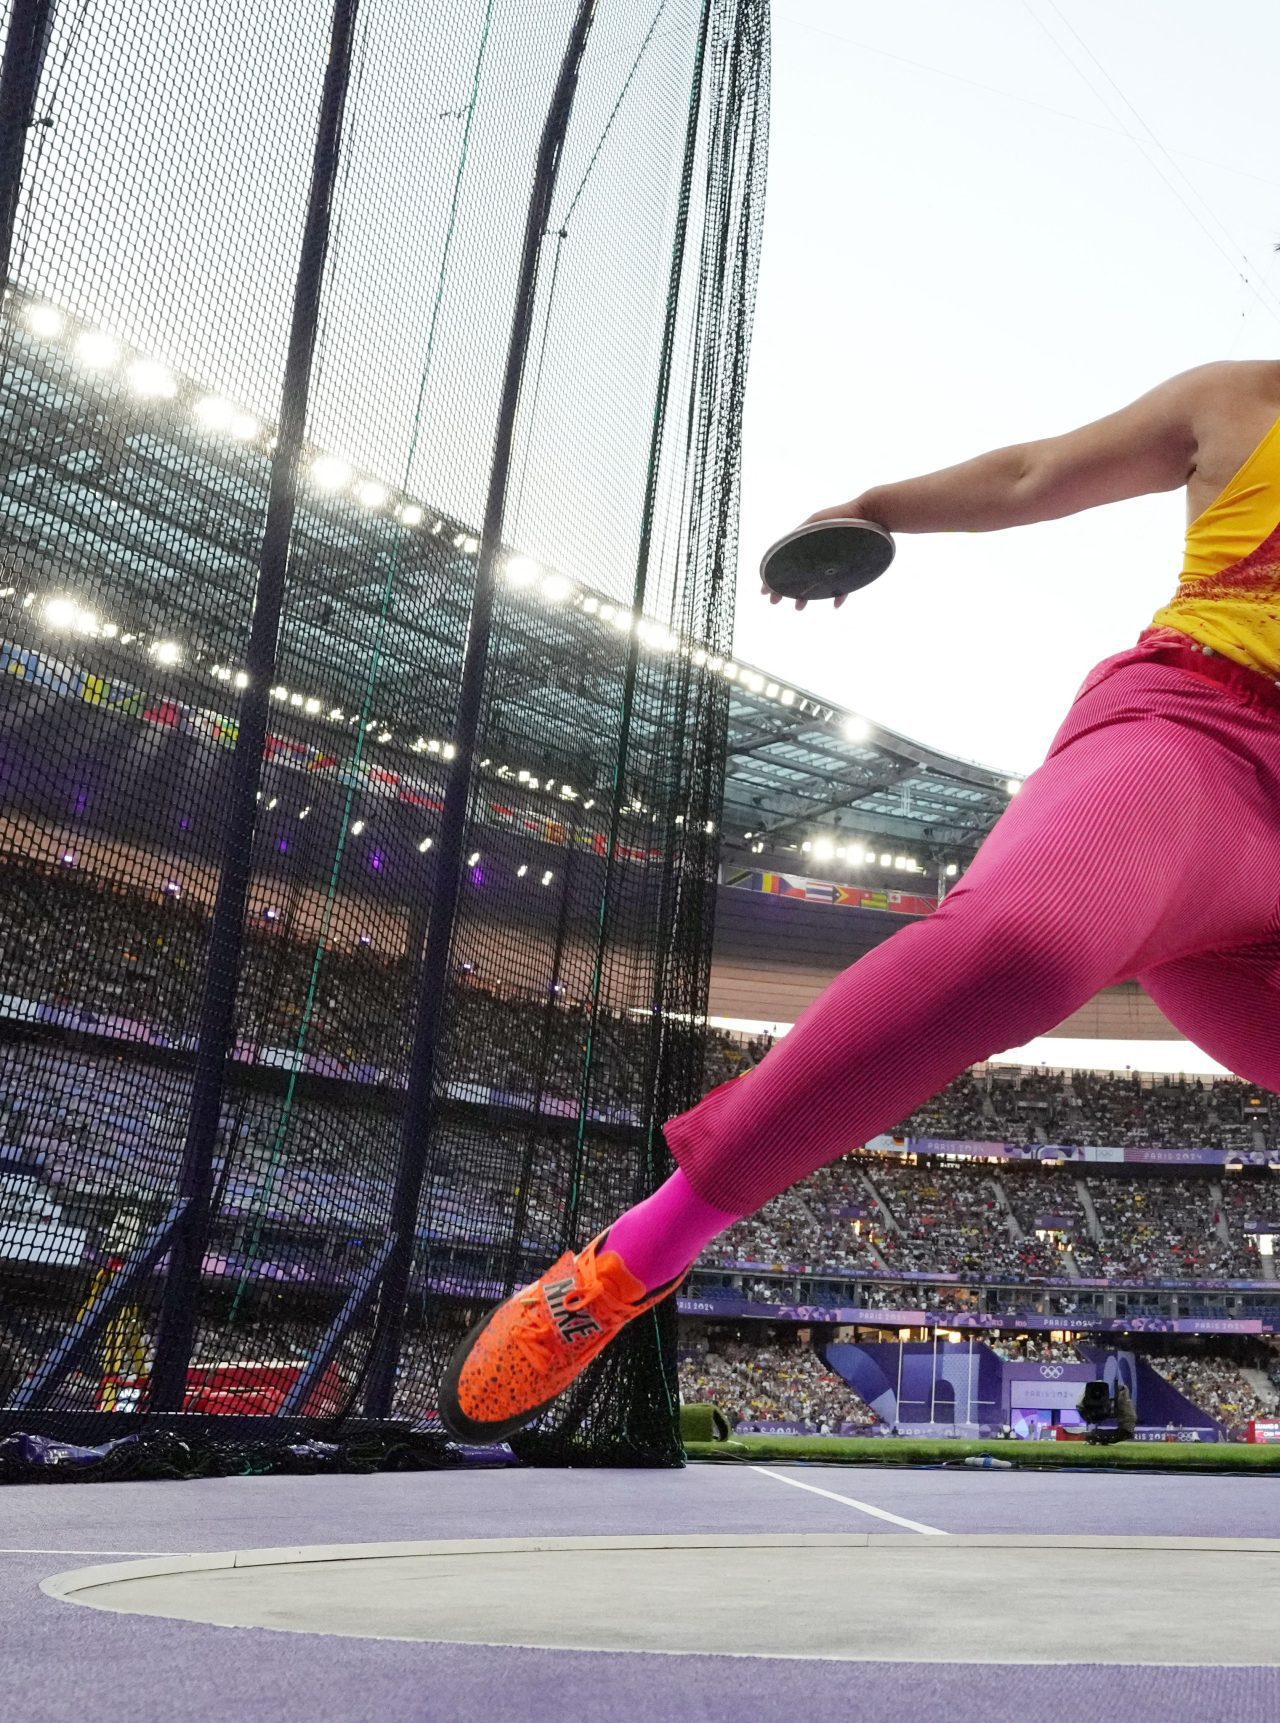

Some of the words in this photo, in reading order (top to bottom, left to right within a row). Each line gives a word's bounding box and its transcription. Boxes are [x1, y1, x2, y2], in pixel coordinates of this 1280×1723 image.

[927, 1142, 956, 1152] PARIS
[1144, 1152, 1174, 1161] PARIS
[693, 1302, 714, 1312] 2024
[859, 1311, 882, 1320] PARIS
[1043, 1319, 1068, 1327] PARIS
[1194, 1322, 1220, 1330] PARIS
